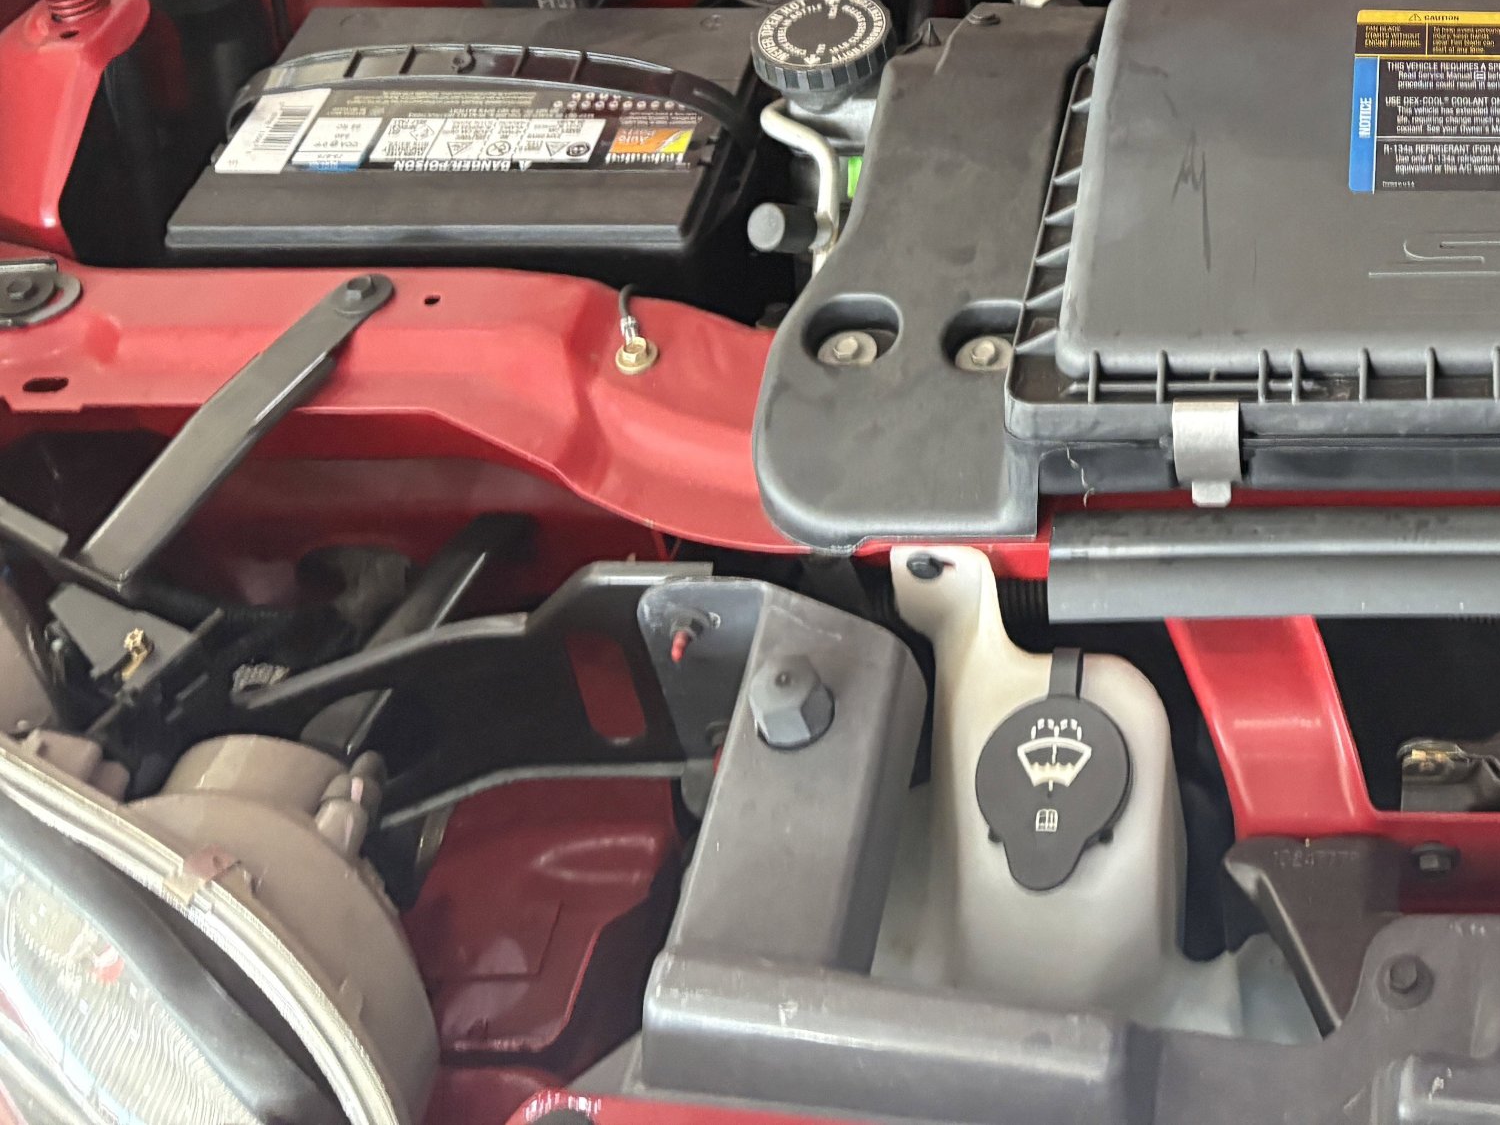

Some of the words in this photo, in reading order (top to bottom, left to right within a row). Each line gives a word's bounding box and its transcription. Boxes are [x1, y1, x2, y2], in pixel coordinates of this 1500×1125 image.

[761, 13, 784, 35] OPEN
[762, 37, 791, 61] NEVER
[1387, 62, 1404, 70] THIS
[1385, 97, 1401, 105] USE
[1452, 97, 1489, 105] COOLANT
[1359, 97, 1372, 138] NOTICE
[1383, 145, 1413, 154] R-134a
[1415, 145, 1470, 154] REFRIGERANT
[1472, 145, 1491, 154] (FOR
